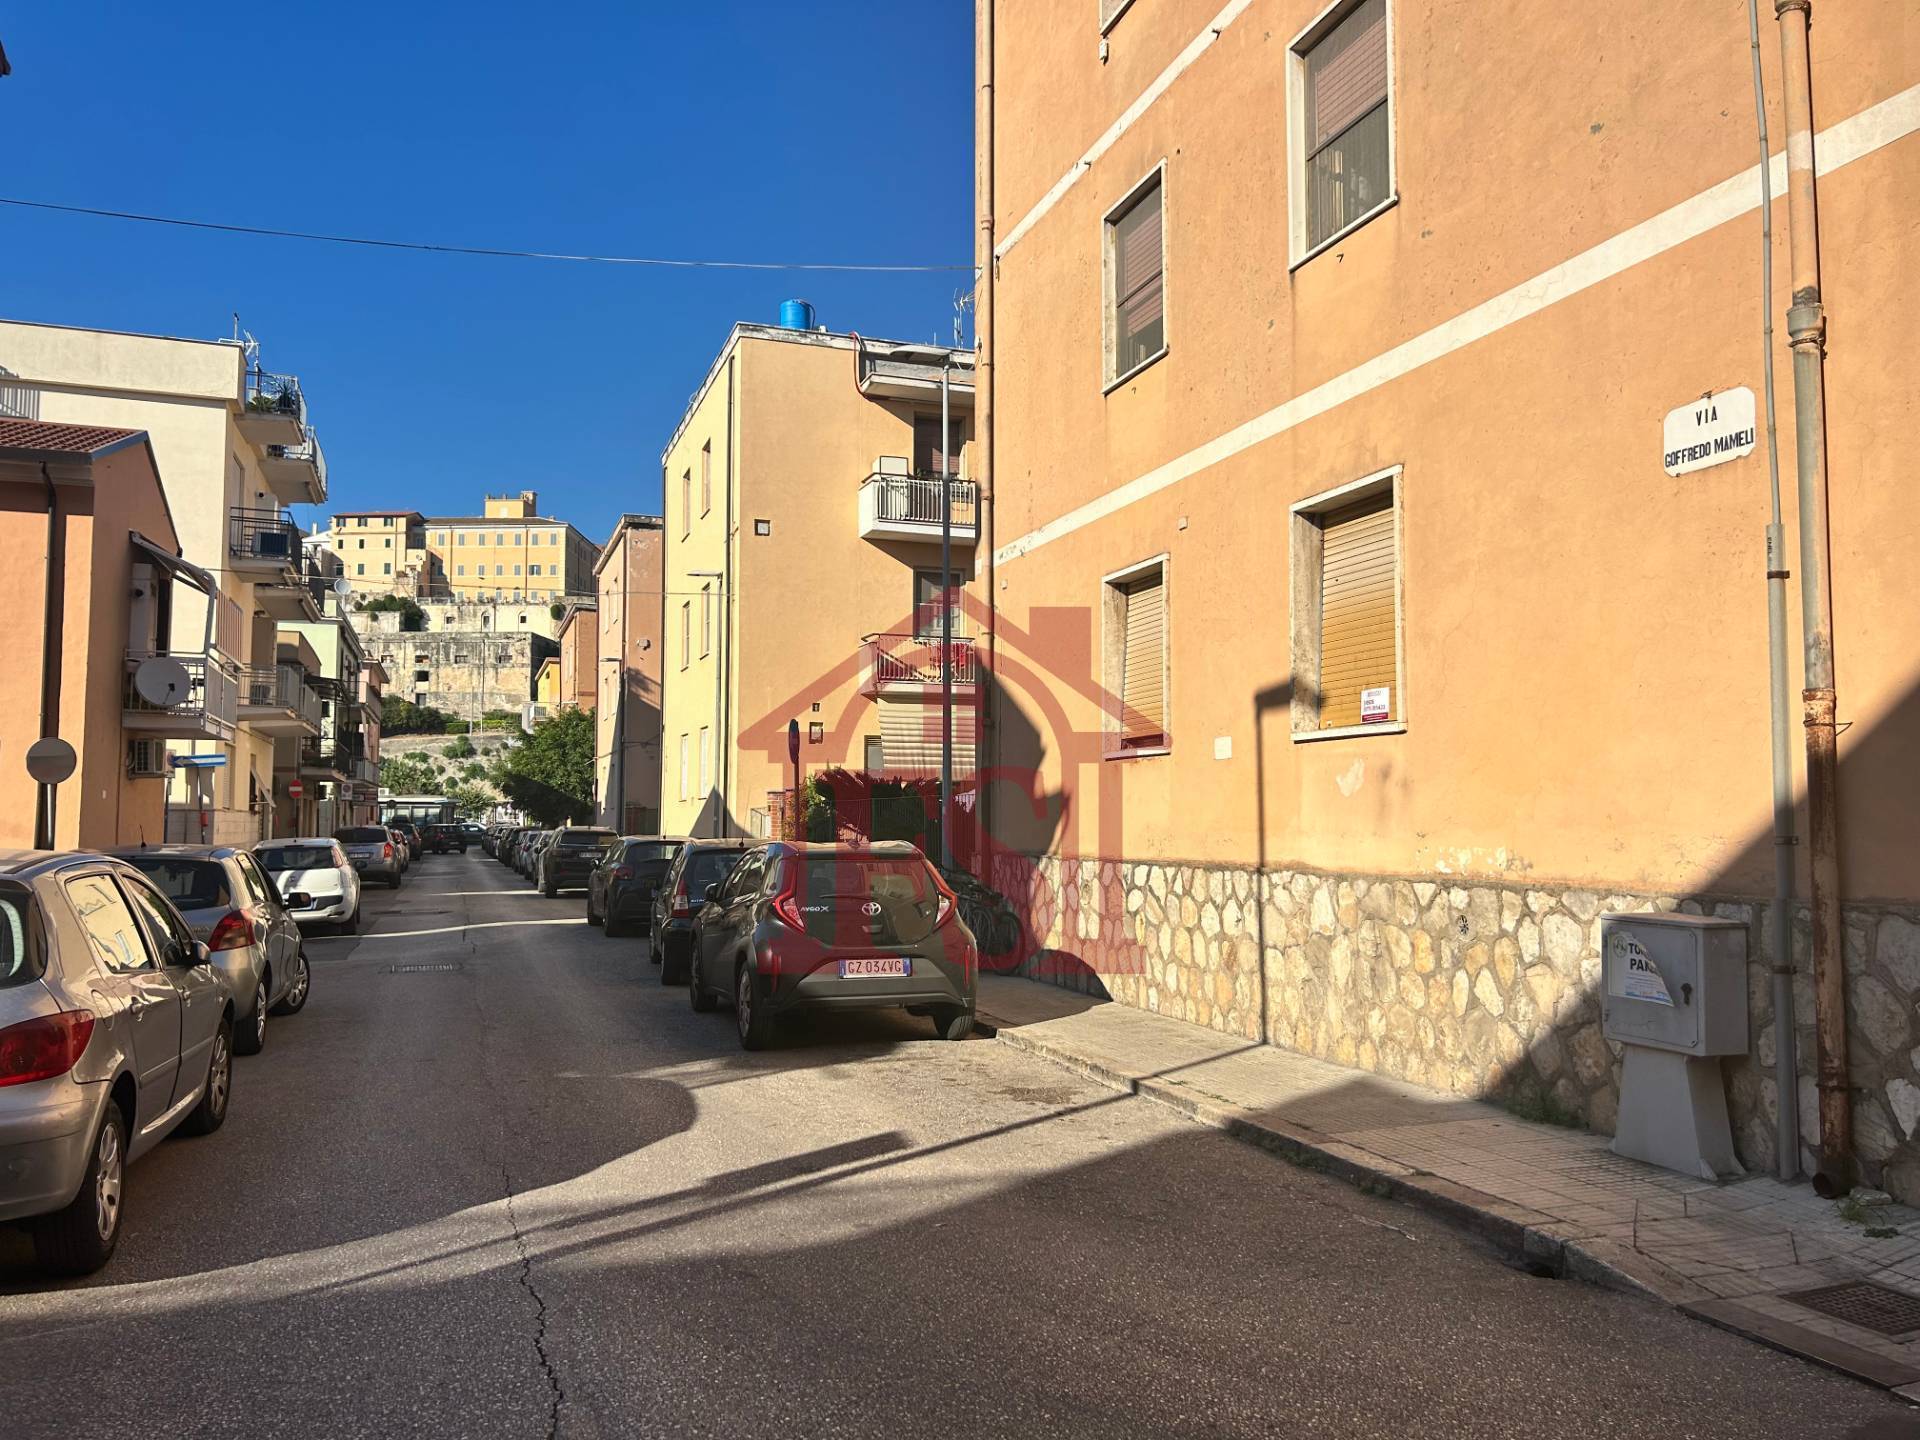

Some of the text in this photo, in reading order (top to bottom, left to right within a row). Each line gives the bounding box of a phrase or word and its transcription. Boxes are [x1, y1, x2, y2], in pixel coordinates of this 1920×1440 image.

[1695, 406, 1718, 426] VIA
[1665, 427, 1754, 468] GOFFREDO MAMELI
[848, 959, 902, 974] GZ 034VG
